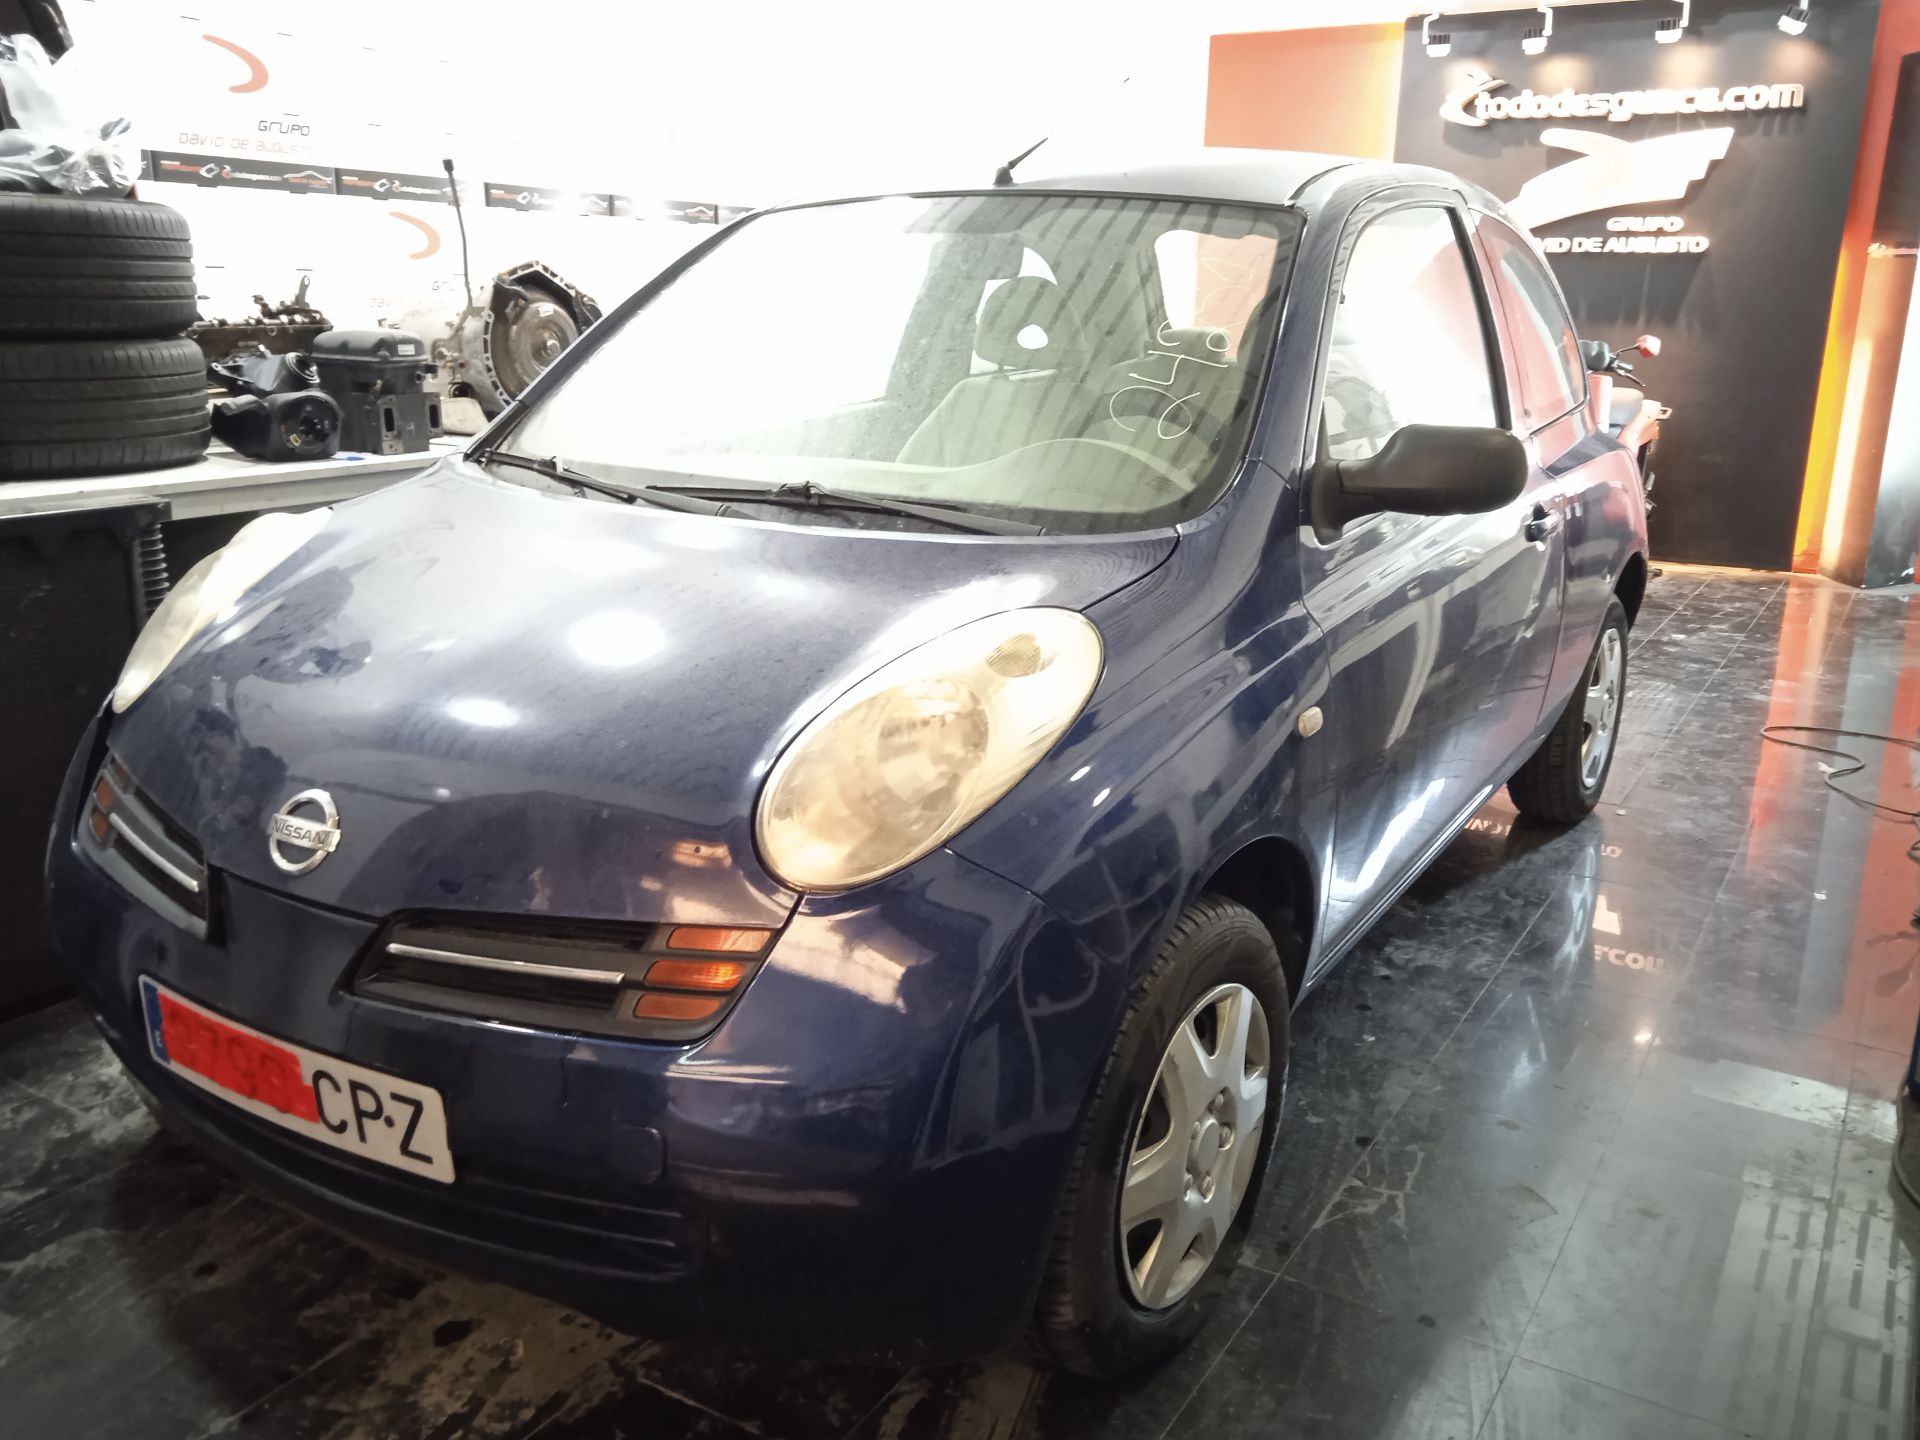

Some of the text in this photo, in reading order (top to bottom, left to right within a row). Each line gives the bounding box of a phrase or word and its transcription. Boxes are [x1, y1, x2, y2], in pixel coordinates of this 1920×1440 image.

[1606, 216, 1684, 232] GRUPO
[1572, 237, 1604, 253] DE
[272, 819, 328, 844] NISSAN
